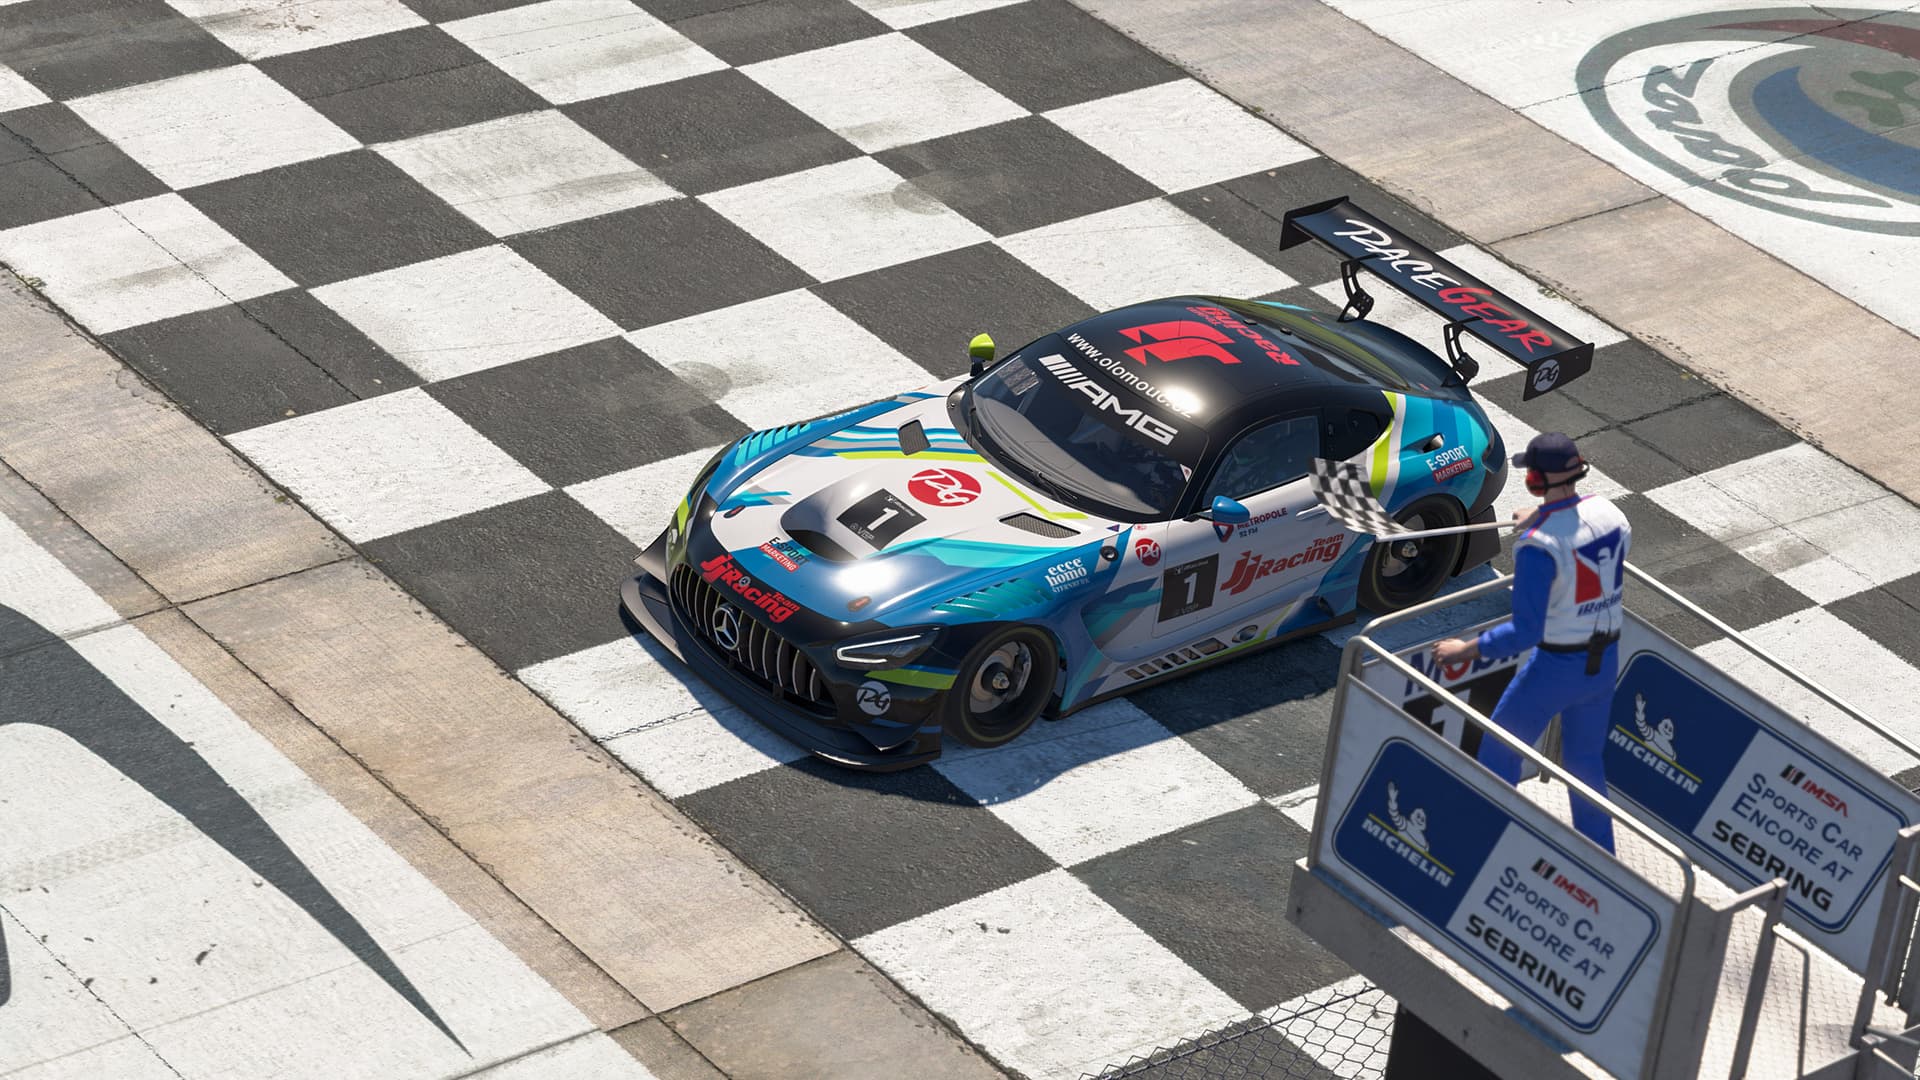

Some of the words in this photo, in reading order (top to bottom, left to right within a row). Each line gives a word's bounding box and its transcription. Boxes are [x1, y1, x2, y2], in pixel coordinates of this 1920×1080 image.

[1425, 445, 1468, 471] E-SPORT
[1434, 459, 1473, 482] MARKETING
[866, 507, 899, 532] 1
[769, 536, 810, 567] E-SPORT
[1312, 533, 1345, 547] Team
[761, 544, 797, 572] MARKETING
[1048, 557, 1083, 576] ecce
[1044, 566, 1088, 587] homo
[1183, 572, 1200, 605] 1
[1608, 729, 1700, 795] MICHELIN
[1802, 779, 1848, 818] IMSA
[1361, 817, 1453, 888] MICHELIN
[1711, 819, 1835, 912] SEBRING
[1821, 860, 1854, 883] AT
[1553, 874, 1600, 914] IMSA
[1464, 912, 1587, 1012] SEBRING
[1573, 960, 1606, 982] AT
